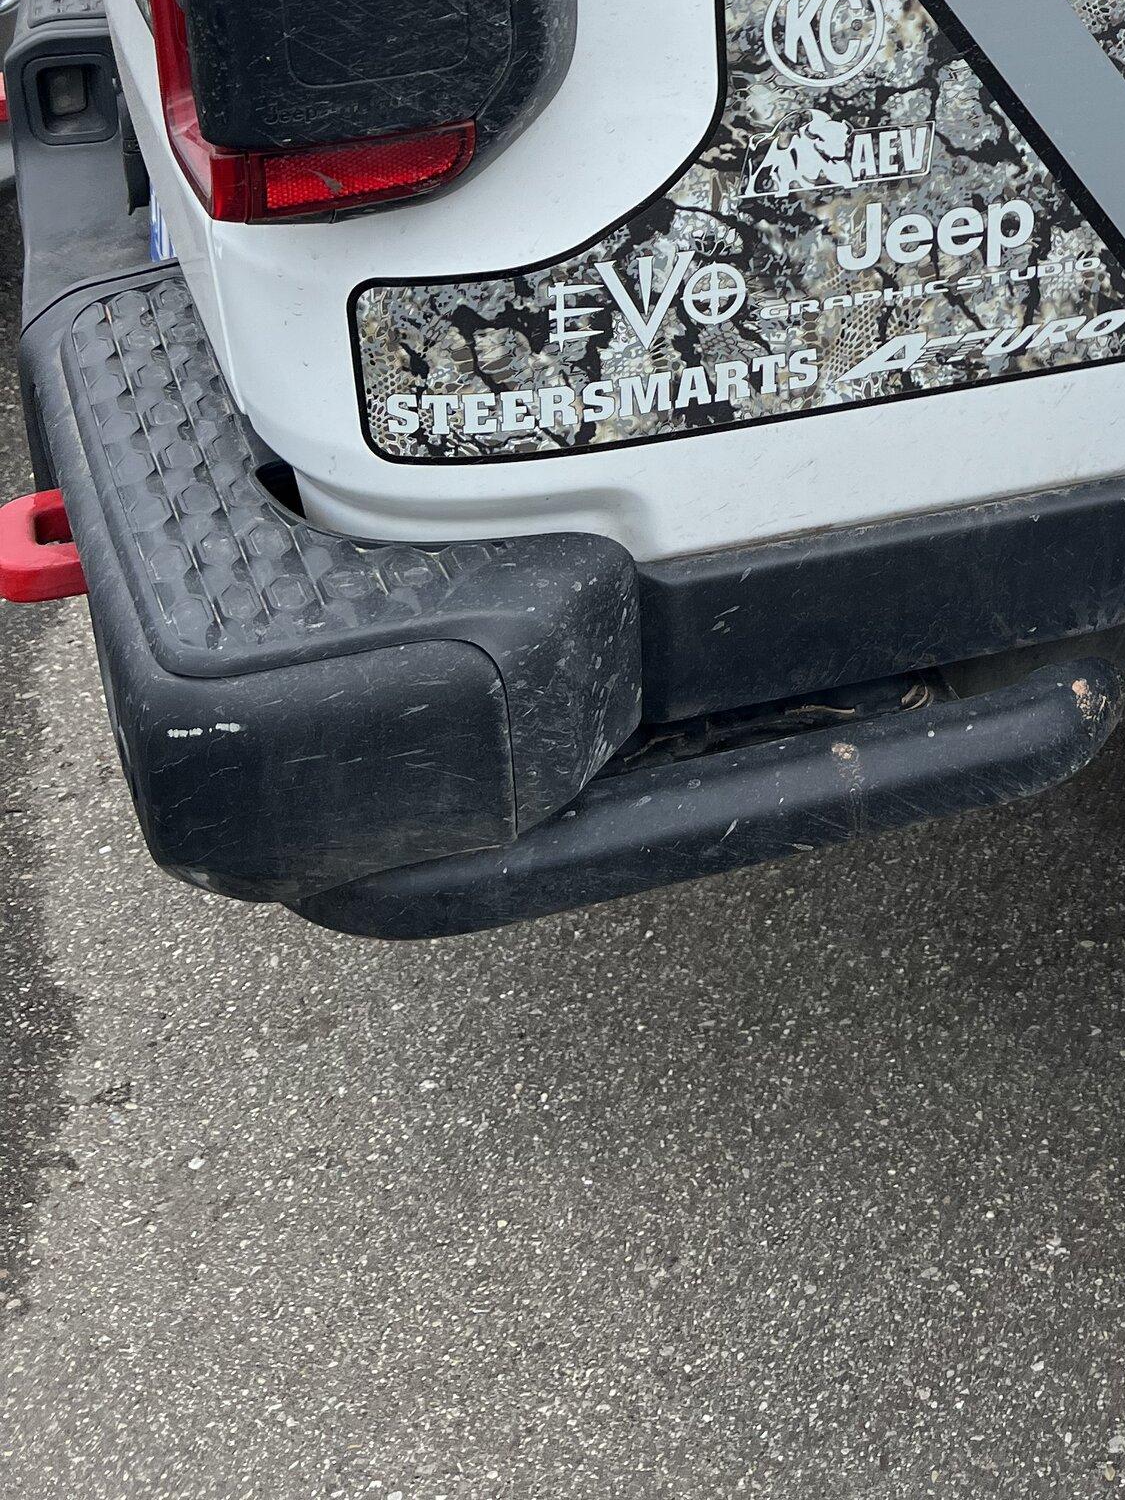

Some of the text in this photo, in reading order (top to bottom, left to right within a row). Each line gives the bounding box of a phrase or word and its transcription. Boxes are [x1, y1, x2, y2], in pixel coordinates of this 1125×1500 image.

[852, 126, 928, 178] AEV
[837, 199, 1035, 271] Jeep
[548, 250, 747, 352] EVO
[760, 257, 1101, 320] GRAPHIC STUDIO
[386, 348, 818, 435] STEERSMARTS
